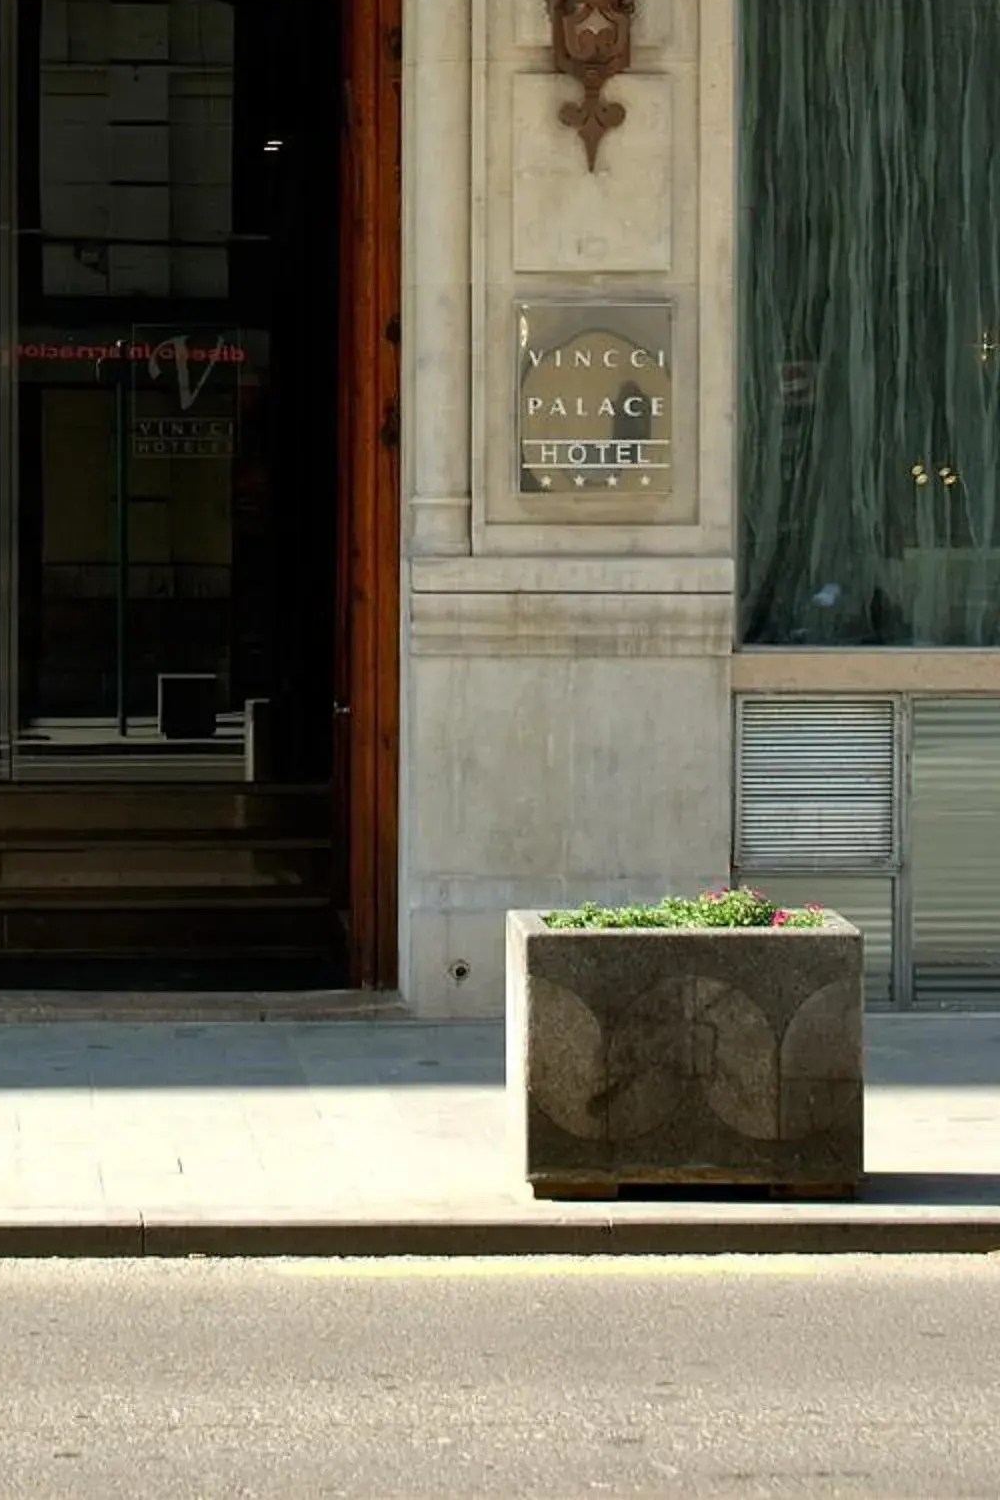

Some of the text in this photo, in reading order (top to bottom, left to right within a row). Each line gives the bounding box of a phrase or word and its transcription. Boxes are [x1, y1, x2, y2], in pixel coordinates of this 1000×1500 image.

[529, 350, 665, 368] VINCCI
[528, 398, 665, 416] PALACE
[541, 444, 651, 463] HOTEL
